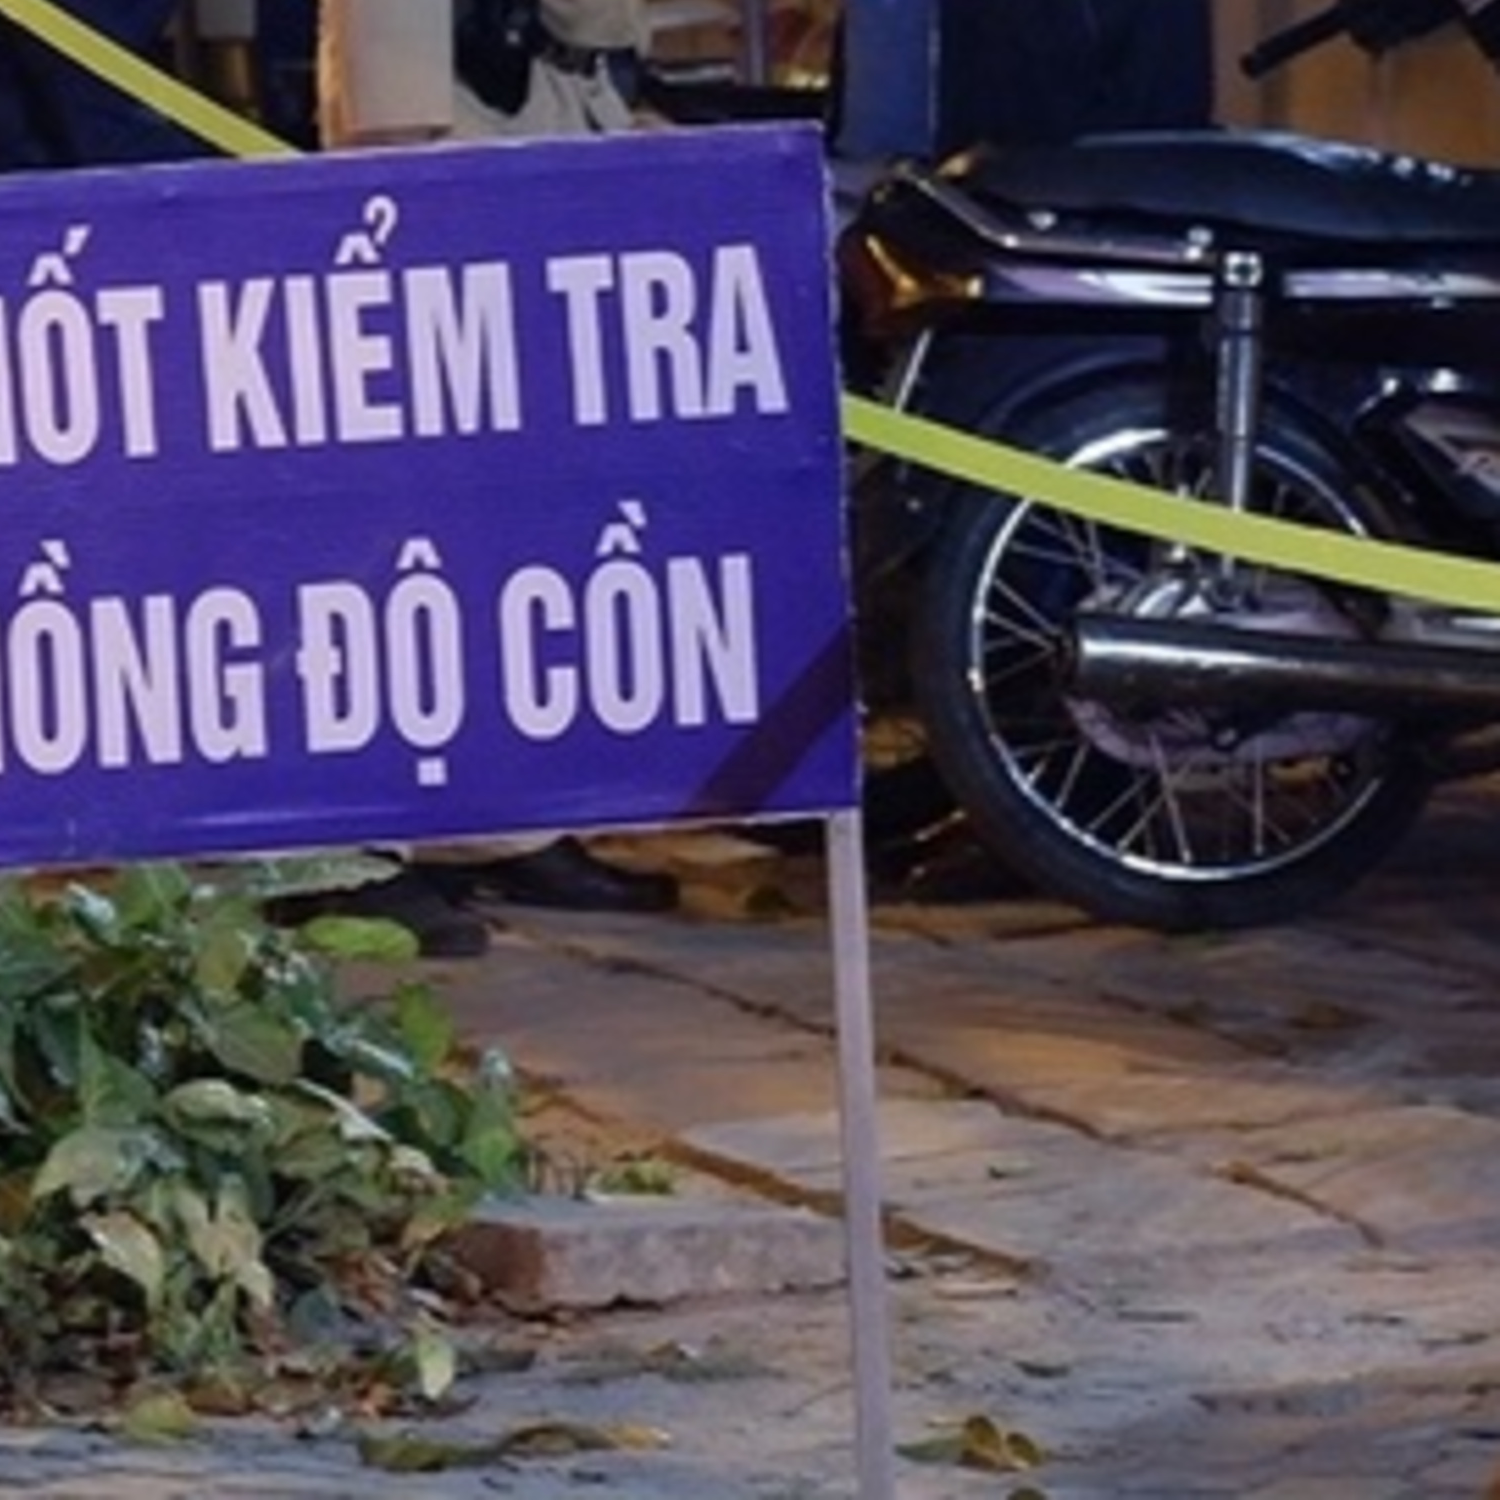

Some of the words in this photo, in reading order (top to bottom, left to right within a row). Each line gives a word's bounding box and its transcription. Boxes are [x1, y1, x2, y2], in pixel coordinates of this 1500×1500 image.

[197, 195, 521, 452] KIỂM
[546, 244, 788, 425] TRA
[295, 538, 464, 786] ĐỘ
[500, 500, 758, 739] CỒN
